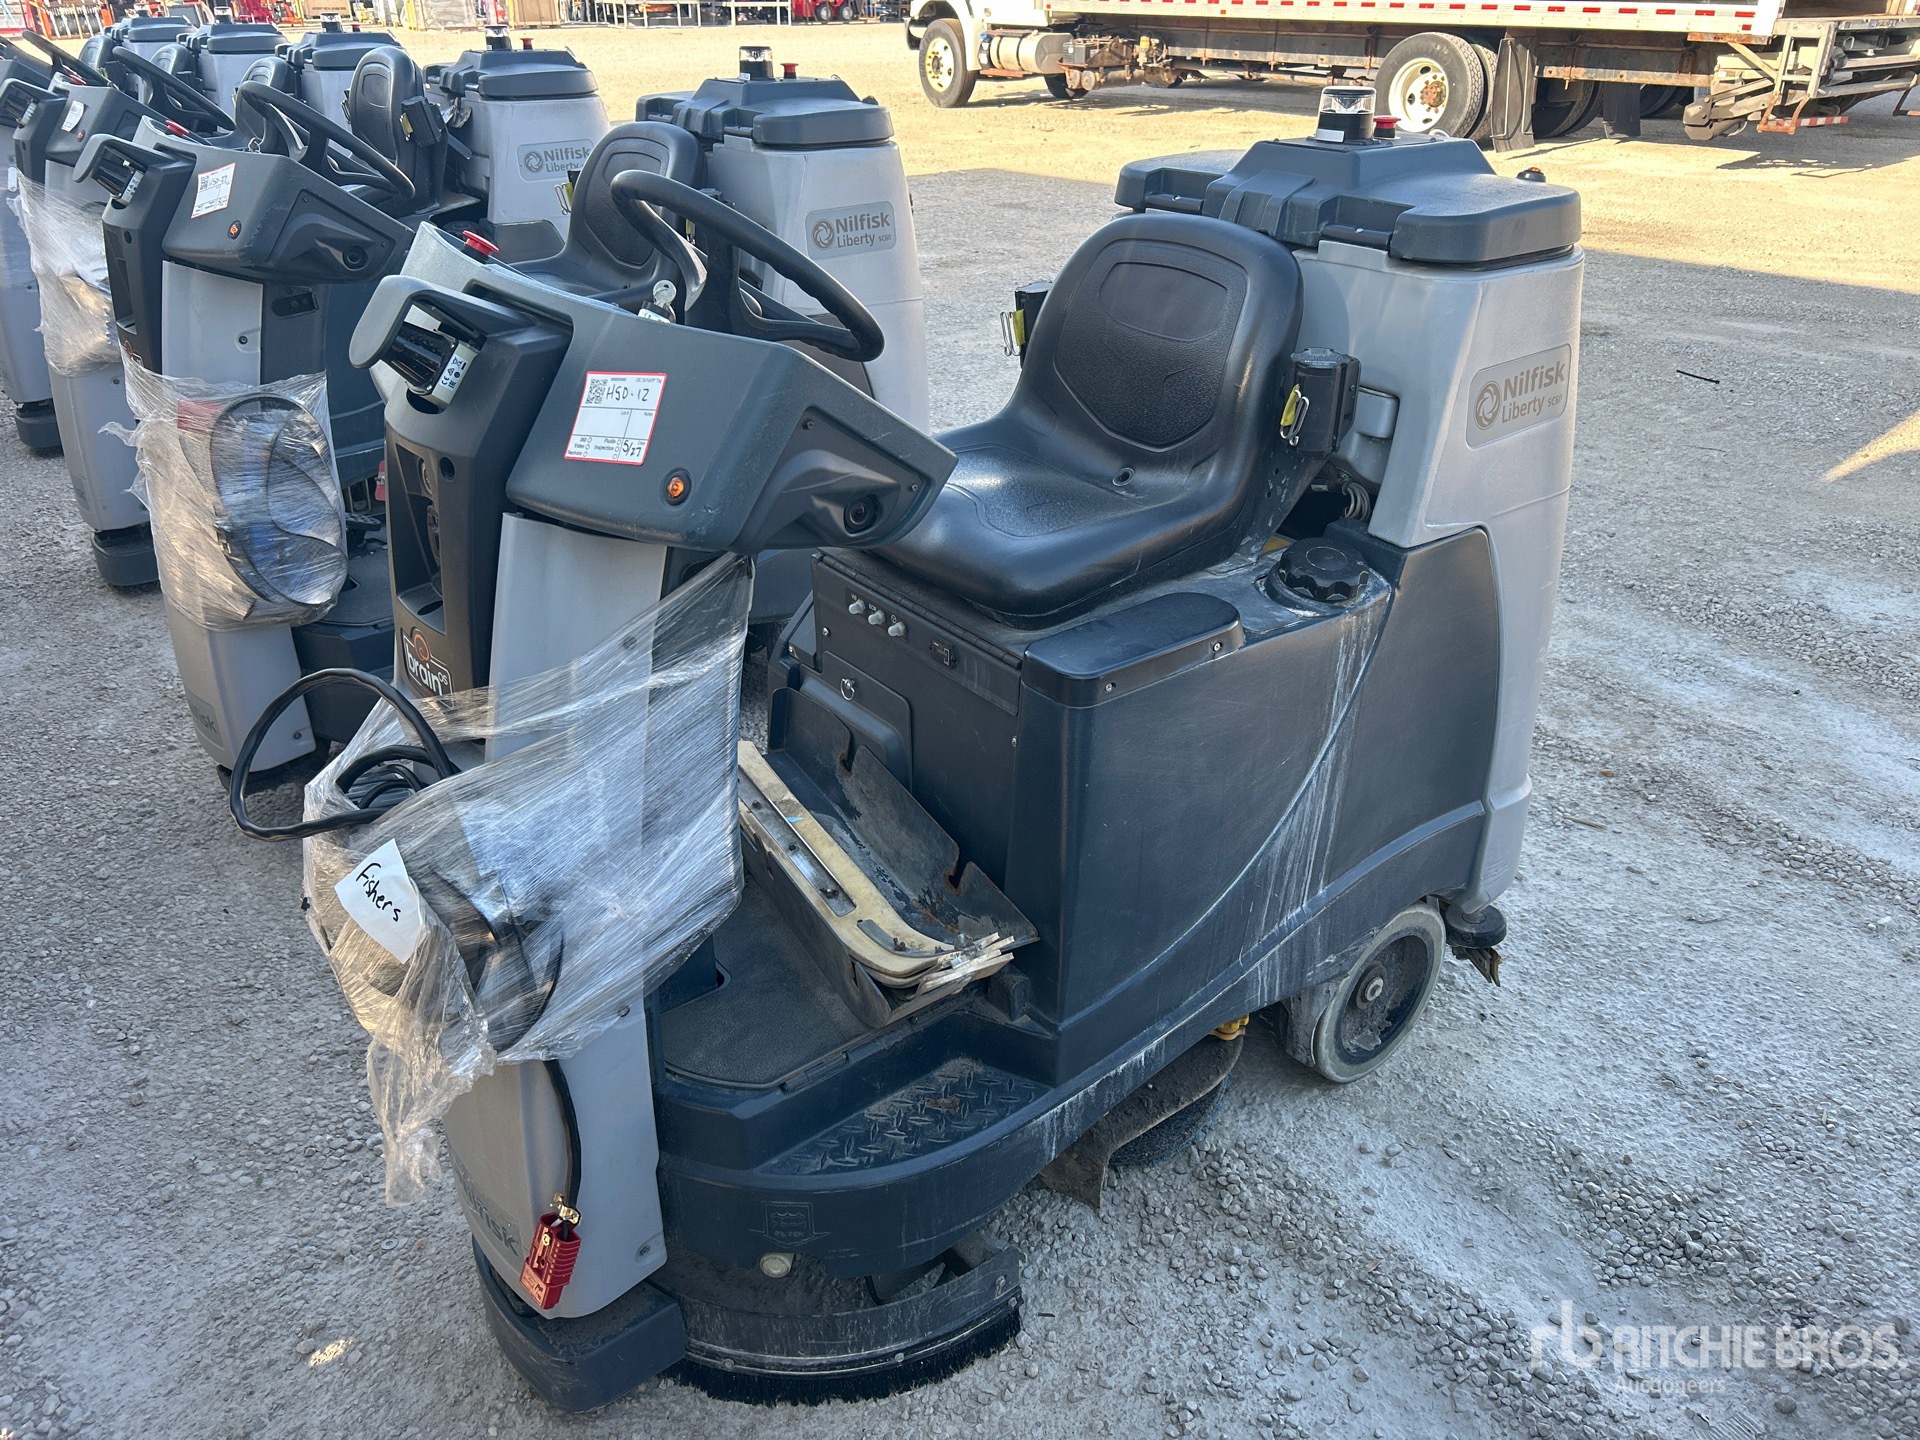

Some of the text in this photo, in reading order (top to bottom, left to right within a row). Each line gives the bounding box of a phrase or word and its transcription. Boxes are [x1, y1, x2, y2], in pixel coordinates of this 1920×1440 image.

[544, 147, 591, 161] Nilfisk
[545, 161, 579, 172] Liberty
[835, 212, 891, 233] Nilfisk
[837, 233, 875, 248] Liberty
[1503, 361, 1566, 402] Nilfisk
[1502, 396, 1545, 424] Liberty
[405, 643, 443, 697] brain
[355, 862, 401, 922] Fishers
